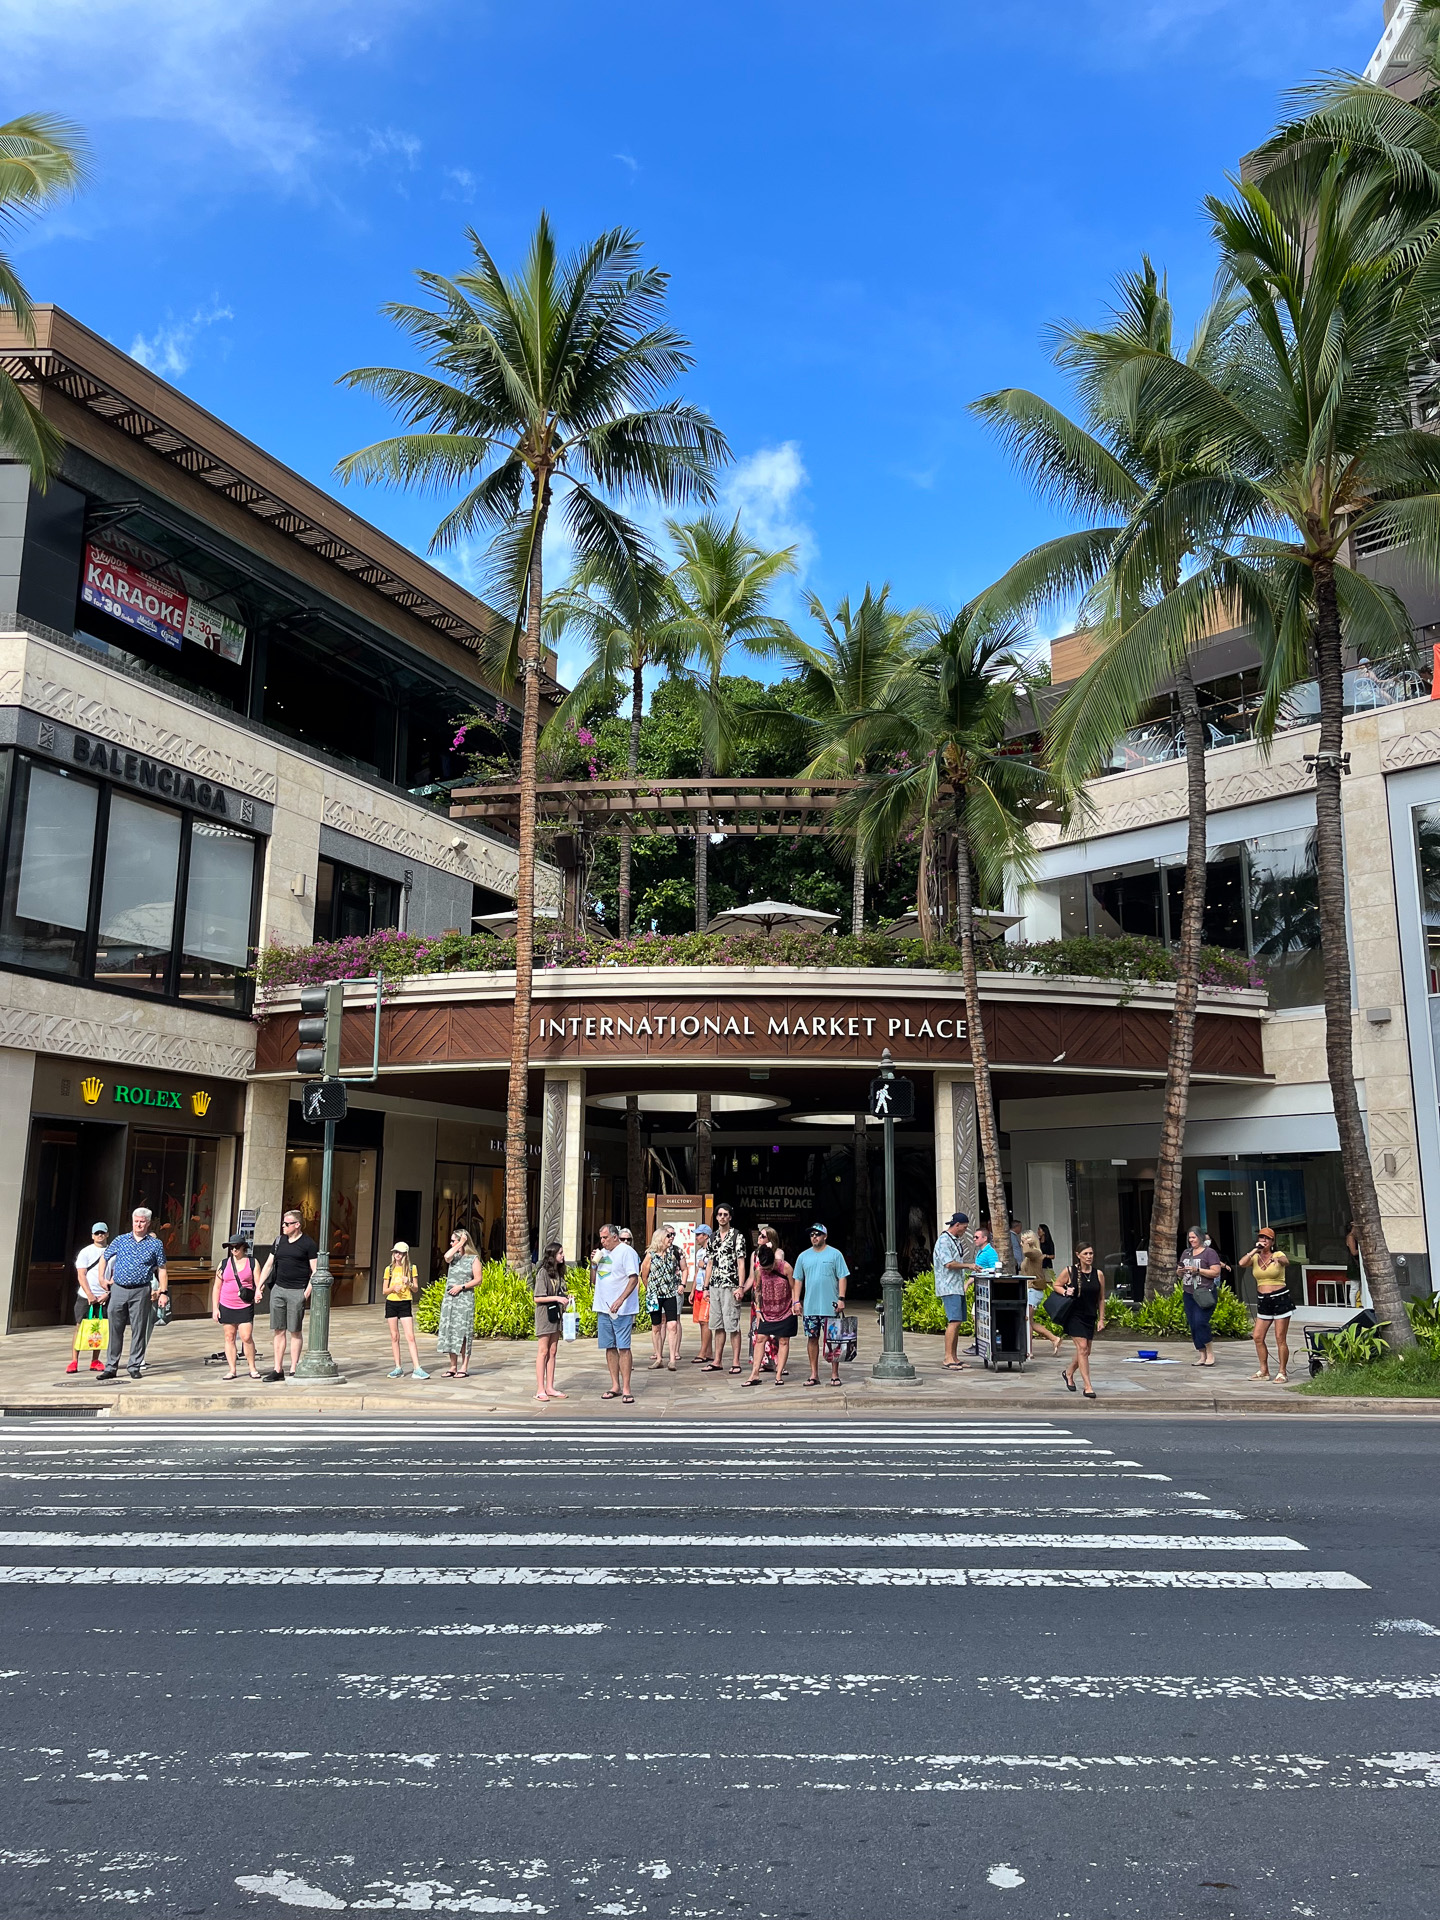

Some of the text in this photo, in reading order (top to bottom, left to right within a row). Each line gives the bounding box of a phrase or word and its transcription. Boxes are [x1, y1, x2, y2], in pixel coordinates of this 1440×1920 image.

[84, 587, 93, 602] 5
[93, 597, 103, 608] for
[87, 563, 183, 629] KARAOKE
[188, 616, 195, 627] 5
[73, 734, 227, 814] BALENCIAGA
[539, 1015, 968, 1040] INTERNATIONAL MARKET PLACE
[114, 1085, 182, 1109] ROLEX
[783, 1197, 813, 1209] PLACE
